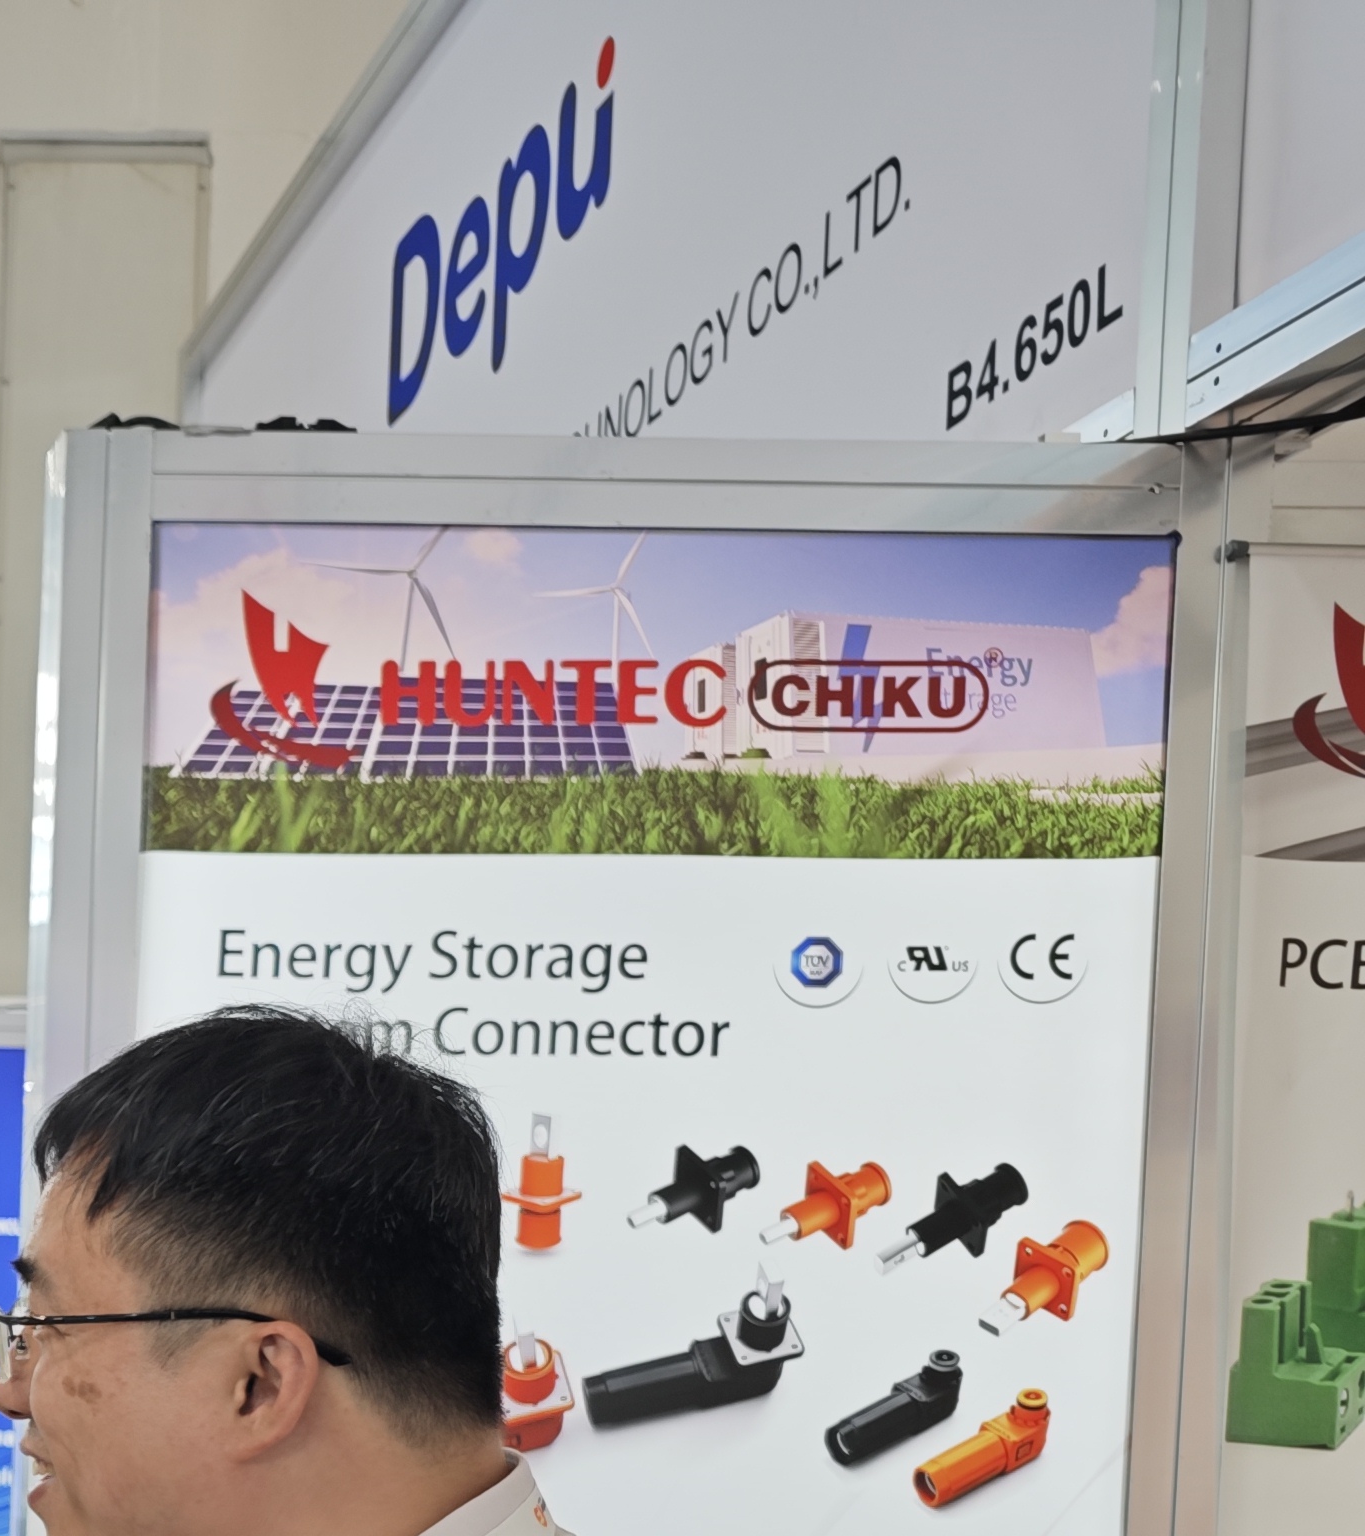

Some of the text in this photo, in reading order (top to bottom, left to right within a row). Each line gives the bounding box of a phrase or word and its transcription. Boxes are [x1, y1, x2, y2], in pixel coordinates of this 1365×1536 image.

[572, 291, 739, 438] NOLOGY
[946, 263, 1124, 432] B4.650L
[379, 659, 728, 728] HUNTEC
[771, 674, 967, 719] CHIKU
[216, 928, 649, 993] Energy Storage
[1010, 933, 1075, 980] CE
[432, 1007, 730, 1058] Connector
